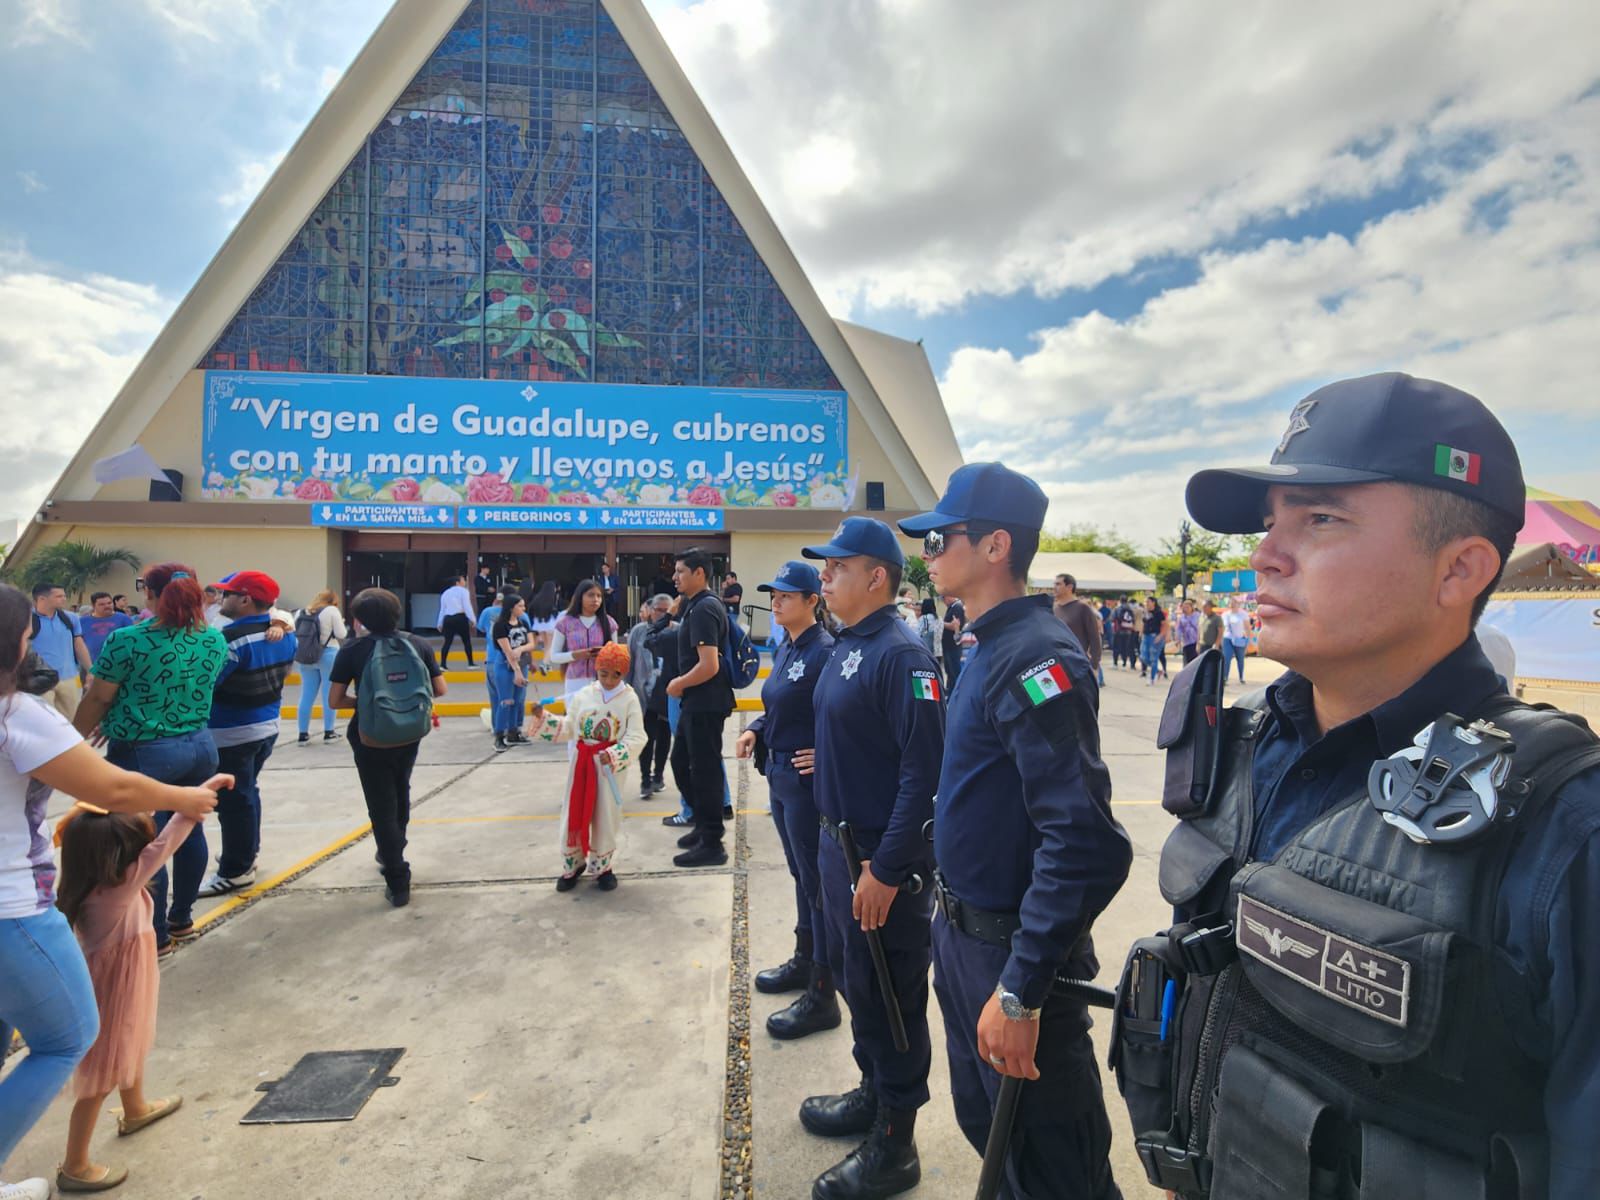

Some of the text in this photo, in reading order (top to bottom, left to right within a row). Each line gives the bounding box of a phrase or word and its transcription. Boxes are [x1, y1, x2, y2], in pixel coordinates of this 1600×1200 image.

[230, 398, 826, 446] "Virgen de Guadalupe, cubrenos
[229, 446, 824, 484] con tu manto y llevanos a Jesús"
[345, 505, 425, 515] PARTICIPANTES
[484, 510, 572, 522] PEREGRINOS
[622, 509, 696, 519] PARTICIPANTES
[335, 513, 434, 524] EN LA SANTA MISA
[613, 517, 705, 526] EN LA SANTA MISA
[1337, 950, 1388, 980] A+
[1335, 975, 1386, 1009] LITIO
